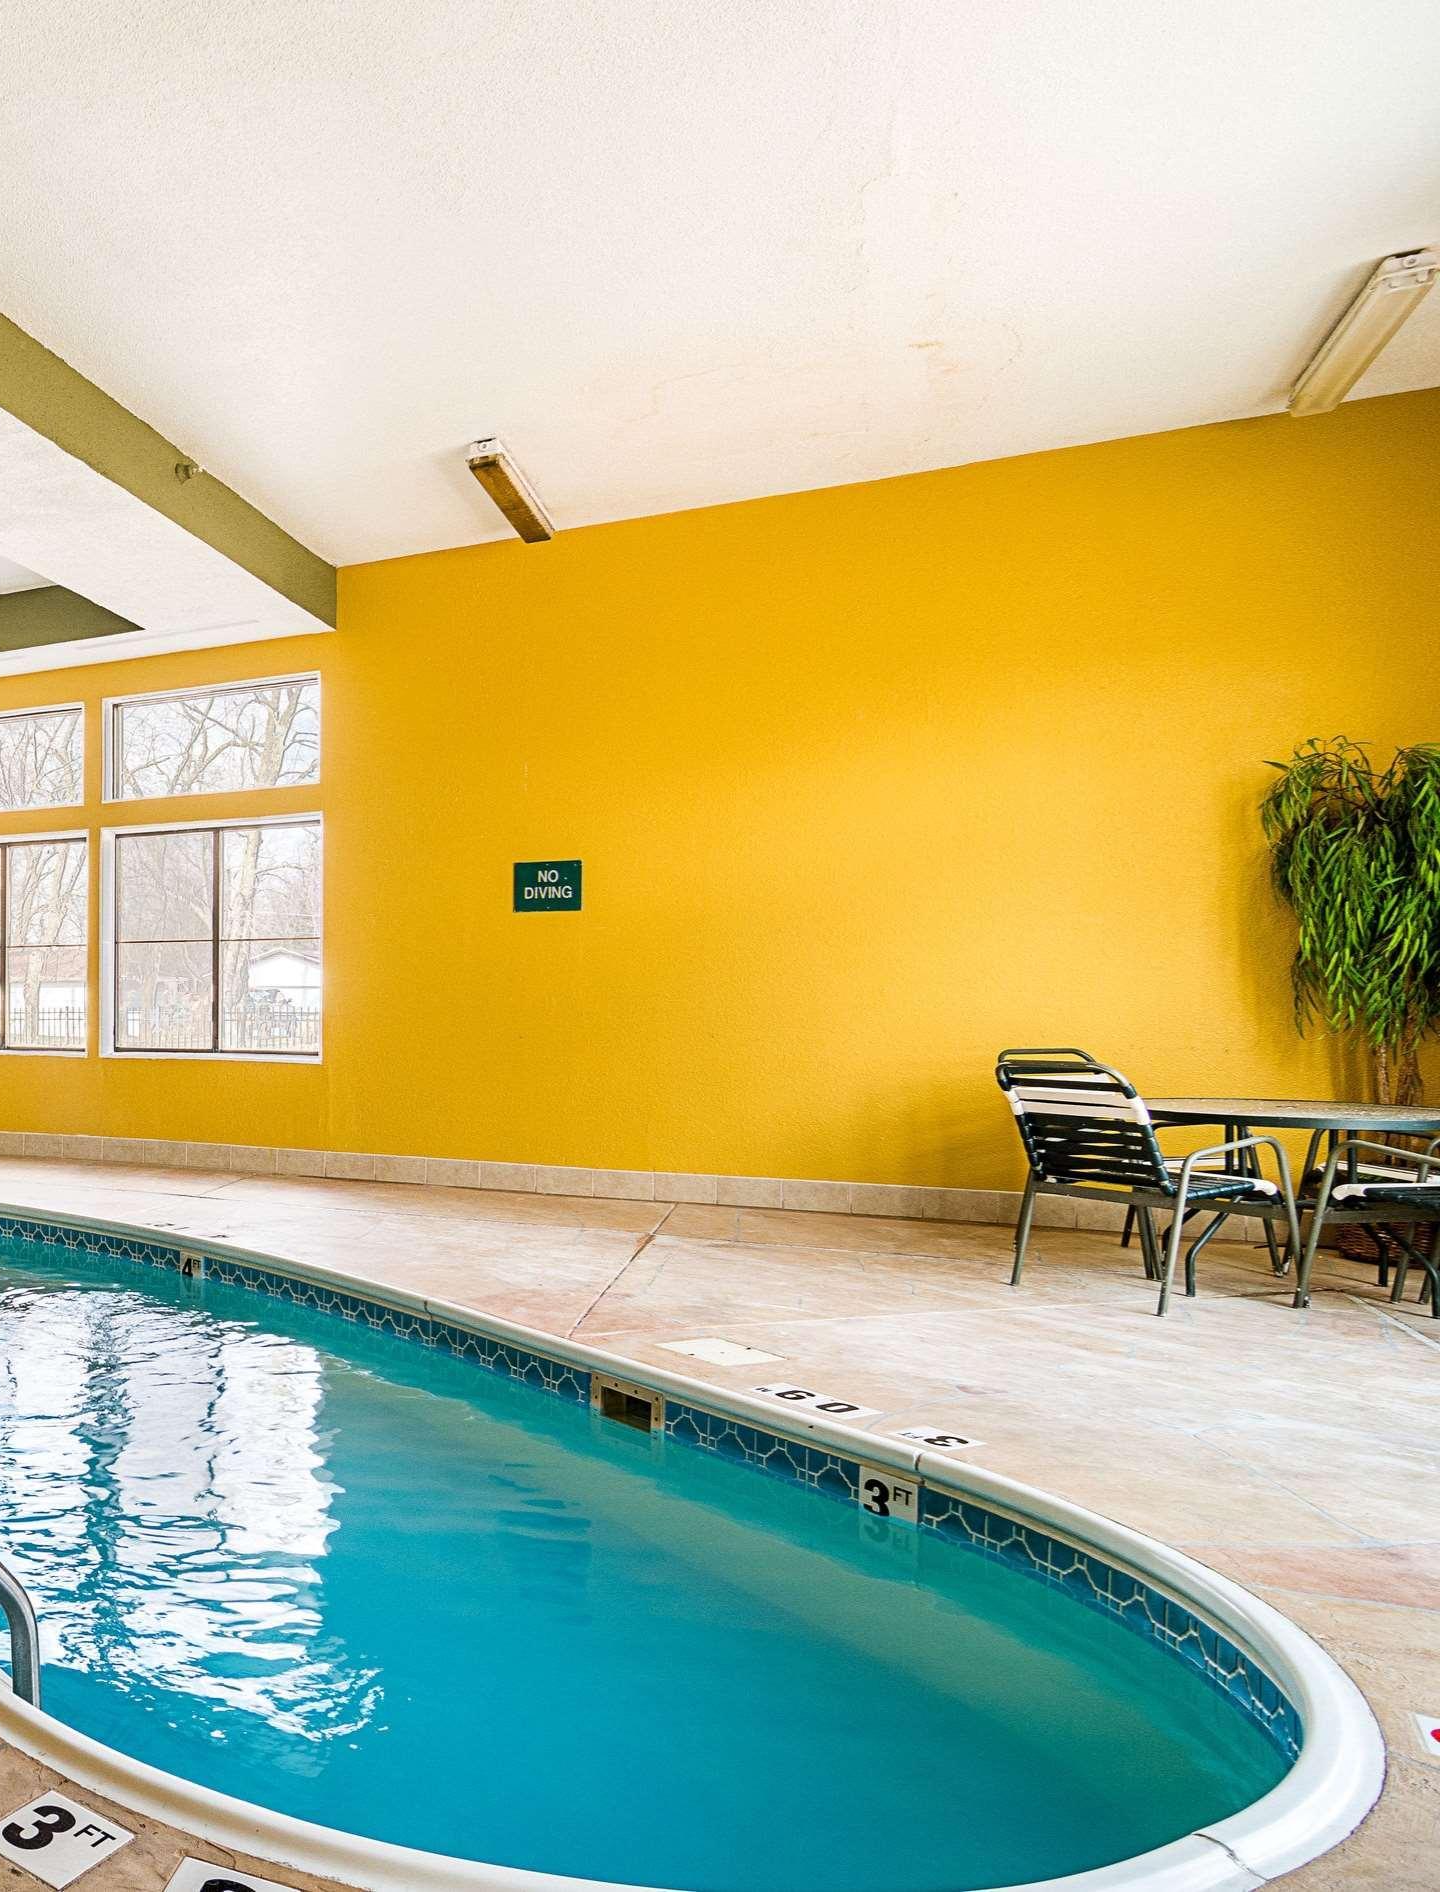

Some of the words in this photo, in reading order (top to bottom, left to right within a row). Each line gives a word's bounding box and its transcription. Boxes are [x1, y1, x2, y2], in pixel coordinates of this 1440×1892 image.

[538, 870, 559, 882] NO
[524, 886, 573, 899] DIVING
[182, 1258, 193, 1277] 4
[923, 1436, 969, 1447] 3
[863, 1478, 890, 1516] 3
[892, 1486, 913, 1507] FT
[2, 1805, 77, 1850] 3
[73, 1823, 117, 1848] FT
